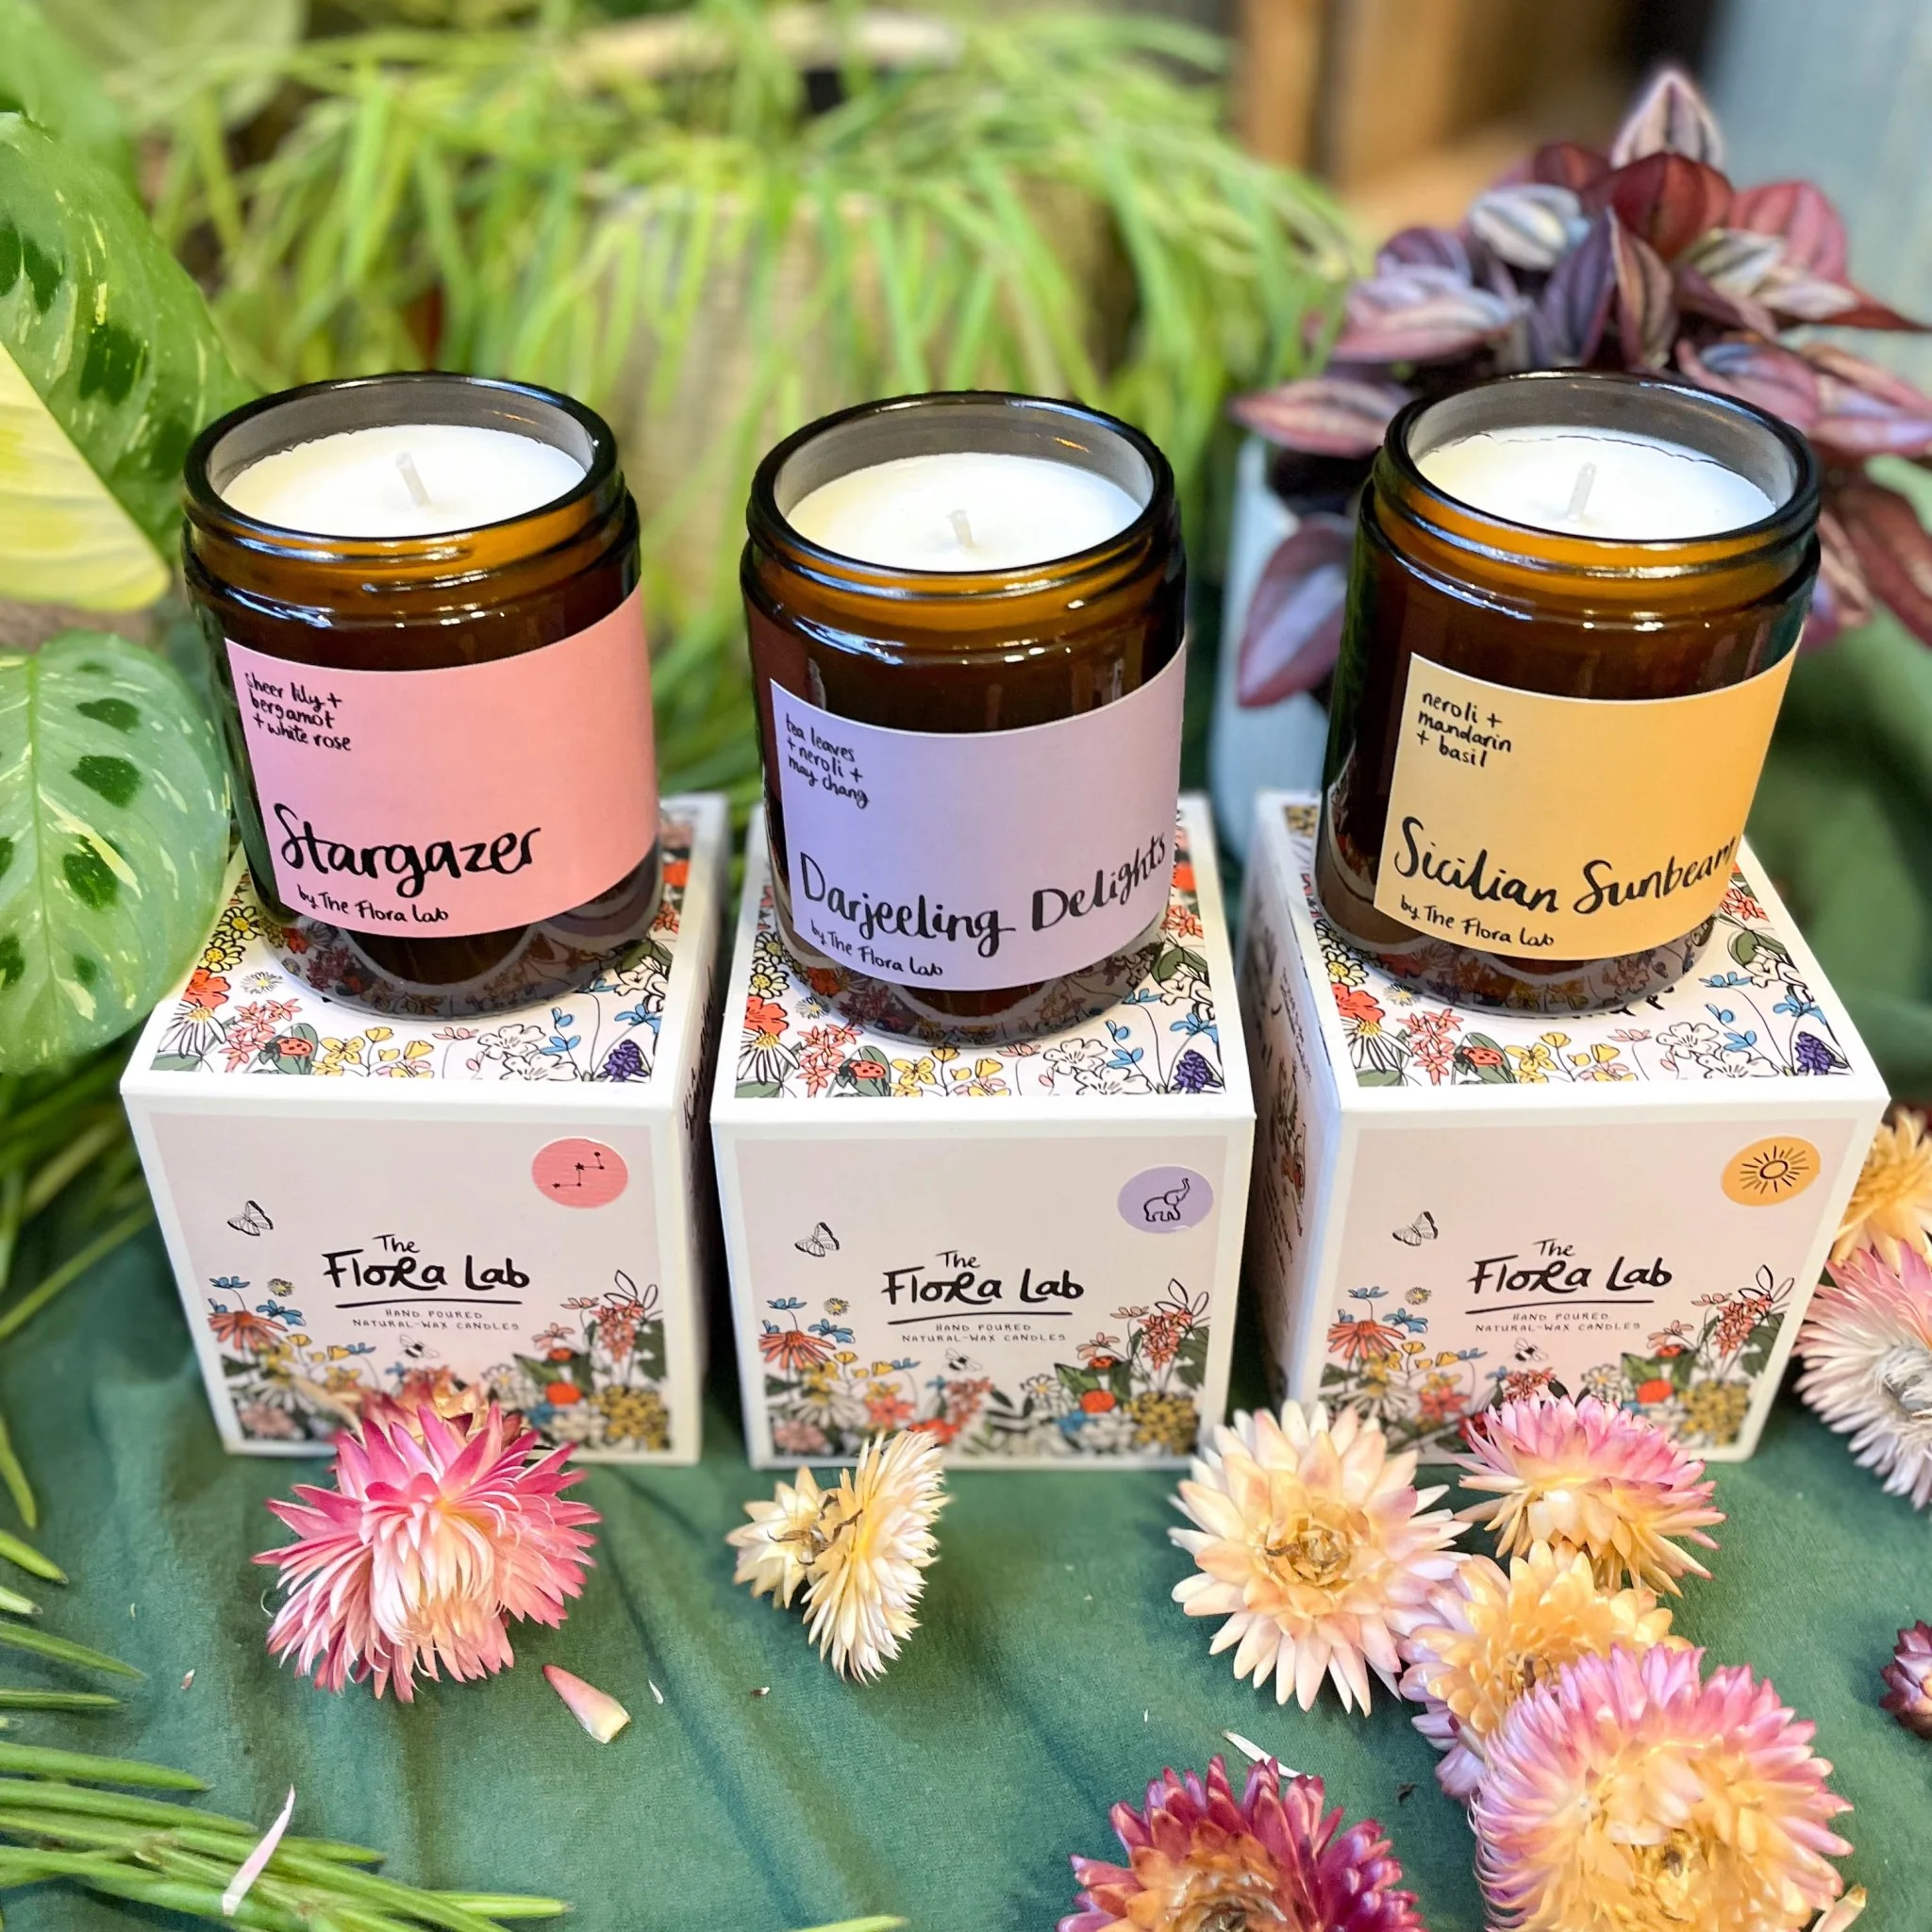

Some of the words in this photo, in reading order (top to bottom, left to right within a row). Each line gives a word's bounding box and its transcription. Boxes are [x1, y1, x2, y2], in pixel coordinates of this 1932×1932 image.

[245, 672, 283, 698] sheer
[291, 682, 325, 712] lily
[327, 692, 342, 708] +
[249, 688, 335, 729] bergamot
[1423, 692, 1477, 724] neroli
[1487, 712, 1502, 728] +
[253, 713, 264, 728] +
[268, 720, 308, 743] white
[313, 734, 351, 751] rose
[786, 712, 806, 741] tea
[811, 726, 855, 762] leaves
[1417, 730, 1429, 745] +
[1440, 734, 1488, 768] basil
[1418, 710, 1511, 753] mandarin
[789, 755, 818, 787] may
[823, 774, 869, 809] chang
[799, 747, 843, 777] neroli
[850, 768, 863, 783] +
[274, 802, 541, 898] Stargazer
[1394, 816, 1559, 913] Sicilian
[297, 883, 320, 908] by
[318, 891, 349, 914] The
[355, 900, 408, 923] Flora
[800, 851, 1015, 958] Darjeeling
[1031, 831, 1167, 931] Delights
[1400, 894, 1421, 920] by
[1424, 905, 1455, 928] The
[1461, 917, 1512, 943] Flora
[810, 919, 826, 944] by
[827, 931, 853, 956] The
[858, 945, 904, 972] Flora
[372, 1234, 421, 1254] The
[935, 1250, 981, 1269] The
[1532, 1238, 1575, 1257] The
[465, 1255, 530, 1291] Lab
[1020, 1268, 1085, 1303] Lab
[1606, 1257, 1673, 1291] Lab
[385, 1308, 421, 1319] HAND
[428, 1310, 484, 1320] POURED
[456, 1322, 520, 1331] CANDLES
[936, 1323, 971, 1332] HAND
[978, 1324, 1032, 1332] POURED
[1512, 1312, 1547, 1322] HAND
[1555, 1312, 1609, 1321] POURED
[1578, 1323, 1641, 1332] CANDLES
[1004, 1333, 1066, 1342] CANDLES
